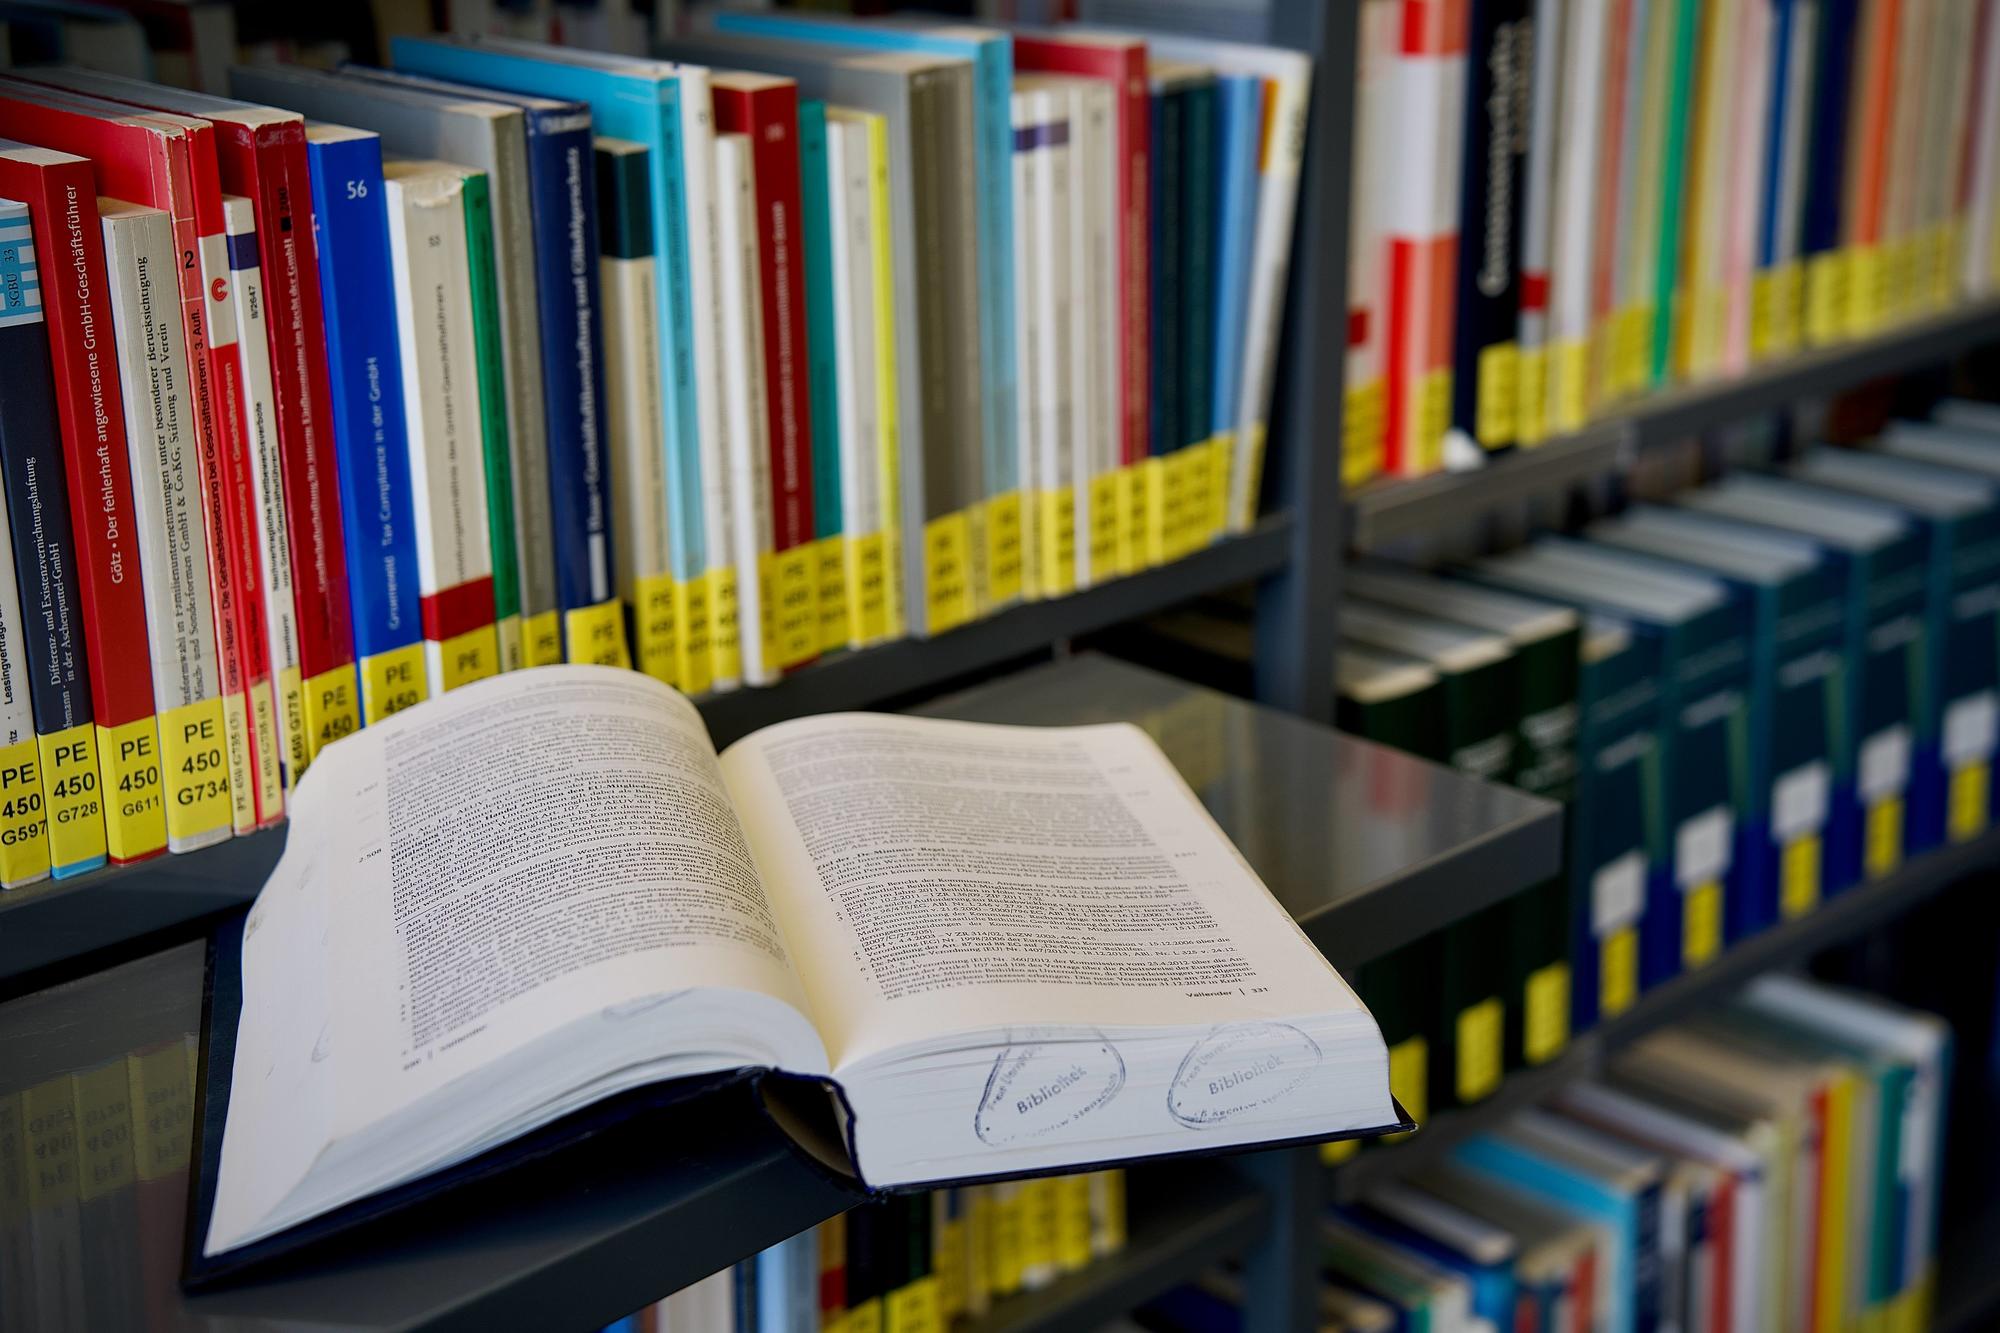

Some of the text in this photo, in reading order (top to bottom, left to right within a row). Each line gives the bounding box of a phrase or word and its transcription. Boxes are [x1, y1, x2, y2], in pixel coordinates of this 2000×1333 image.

[347, 179, 367, 200] 56
[184, 251, 195, 269] 2
[284, 238, 296, 275] GmbH
[4, 248, 21, 307] SGBU 33
[288, 276, 300, 297] der
[573, 276, 588, 307] und
[290, 298, 303, 328] Recht
[157, 323, 170, 360] Verein
[66, 185, 124, 585] Götz Der fehlerhaft angewiesene GmbH-Geschäftsführer
[164, 366, 173, 392] und
[366, 356, 382, 401] GmbH
[149, 366, 164, 429] besonderer
[197, 358, 215, 460] Geschäftsführern
[166, 394, 181, 443] Stiftung
[372, 404, 385, 427] der
[374, 428, 385, 442] in
[158, 433, 168, 466] unter
[208, 460, 218, 480] bei
[374, 443, 392, 521] Compliance
[176, 497, 184, 508] &
[176, 511, 190, 551] GmbH
[25, 457, 62, 686] Differenz- und Existenzvernichtungshaftung
[62, 651, 74, 667] der
[457, 648, 480, 673] PE
[66, 669, 75, 682] in
[385, 662, 412, 686] PE
[322, 685, 347, 711] PE
[384, 690, 418, 714] 450
[184, 719, 215, 744] PE
[321, 714, 354, 740] 450
[55, 741, 88, 767] PE
[121, 736, 152, 761] PE
[182, 749, 221, 775] 450
[2, 763, 36, 789] PE
[53, 772, 96, 799] 450
[119, 766, 158, 793] 450
[177, 777, 230, 806] G734
[2, 793, 41, 819] 450
[57, 801, 98, 824] G728
[122, 796, 160, 817] G611
[0, 820, 48, 846] G597
[1208, 1054, 1285, 1096] Bibliothek
[1016, 1063, 1088, 1115] Bibliothek
